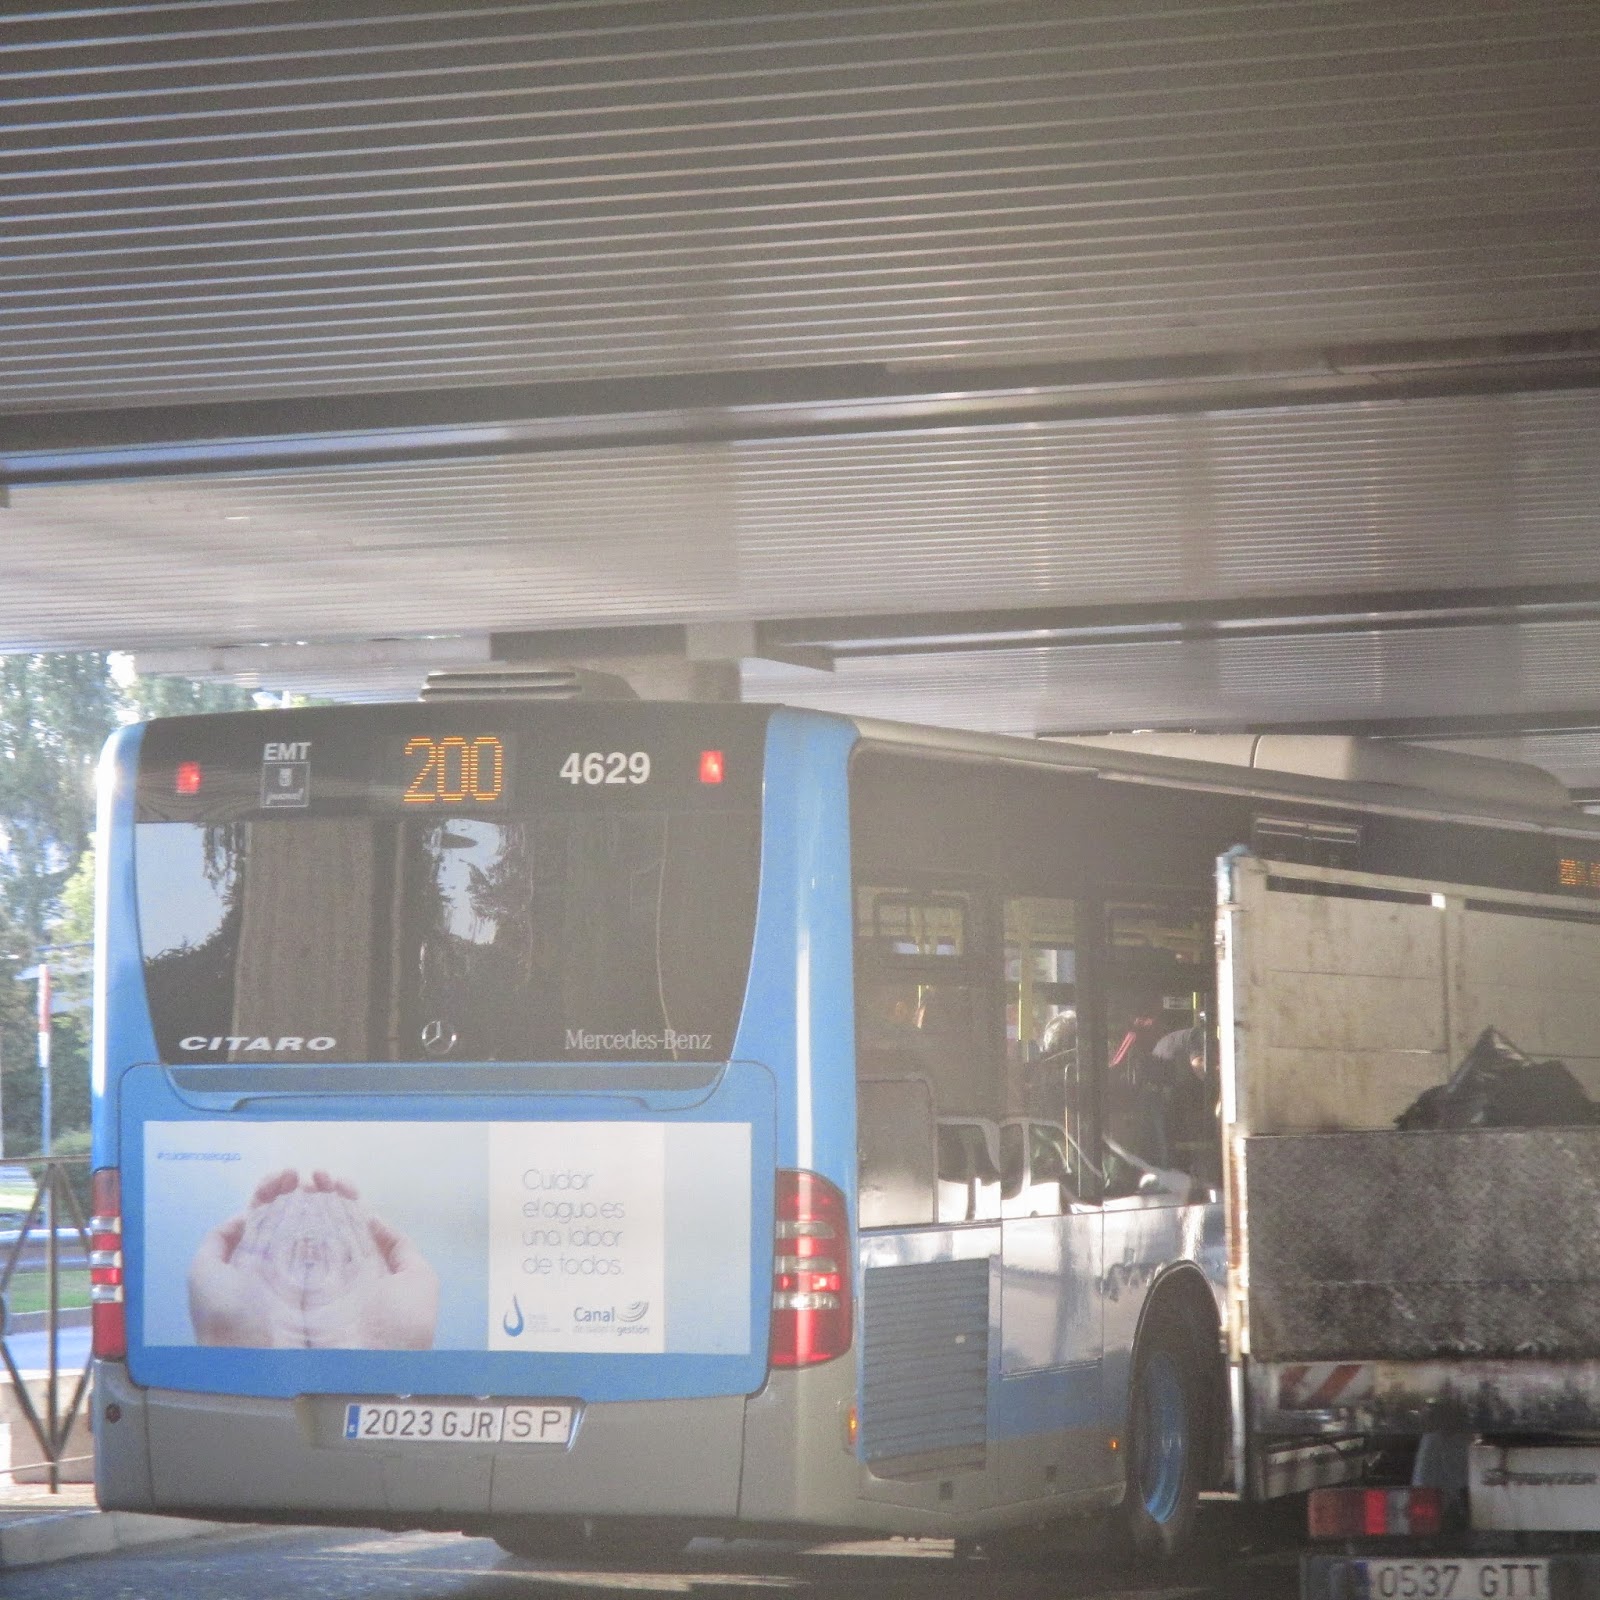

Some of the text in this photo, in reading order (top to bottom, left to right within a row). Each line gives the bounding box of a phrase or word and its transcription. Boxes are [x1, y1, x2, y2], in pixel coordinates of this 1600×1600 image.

[263, 742, 312, 760] EMT
[403, 736, 503, 802] 200
[559, 751, 651, 785] 4629
[178, 1036, 337, 1051] CITARO
[564, 1028, 712, 1051] Mercedes-Benz
[574, 1306, 615, 1322] Canal
[365, 1409, 493, 1438] 2023 GJR
[1379, 1564, 1540, 1598] 0537 GTT
